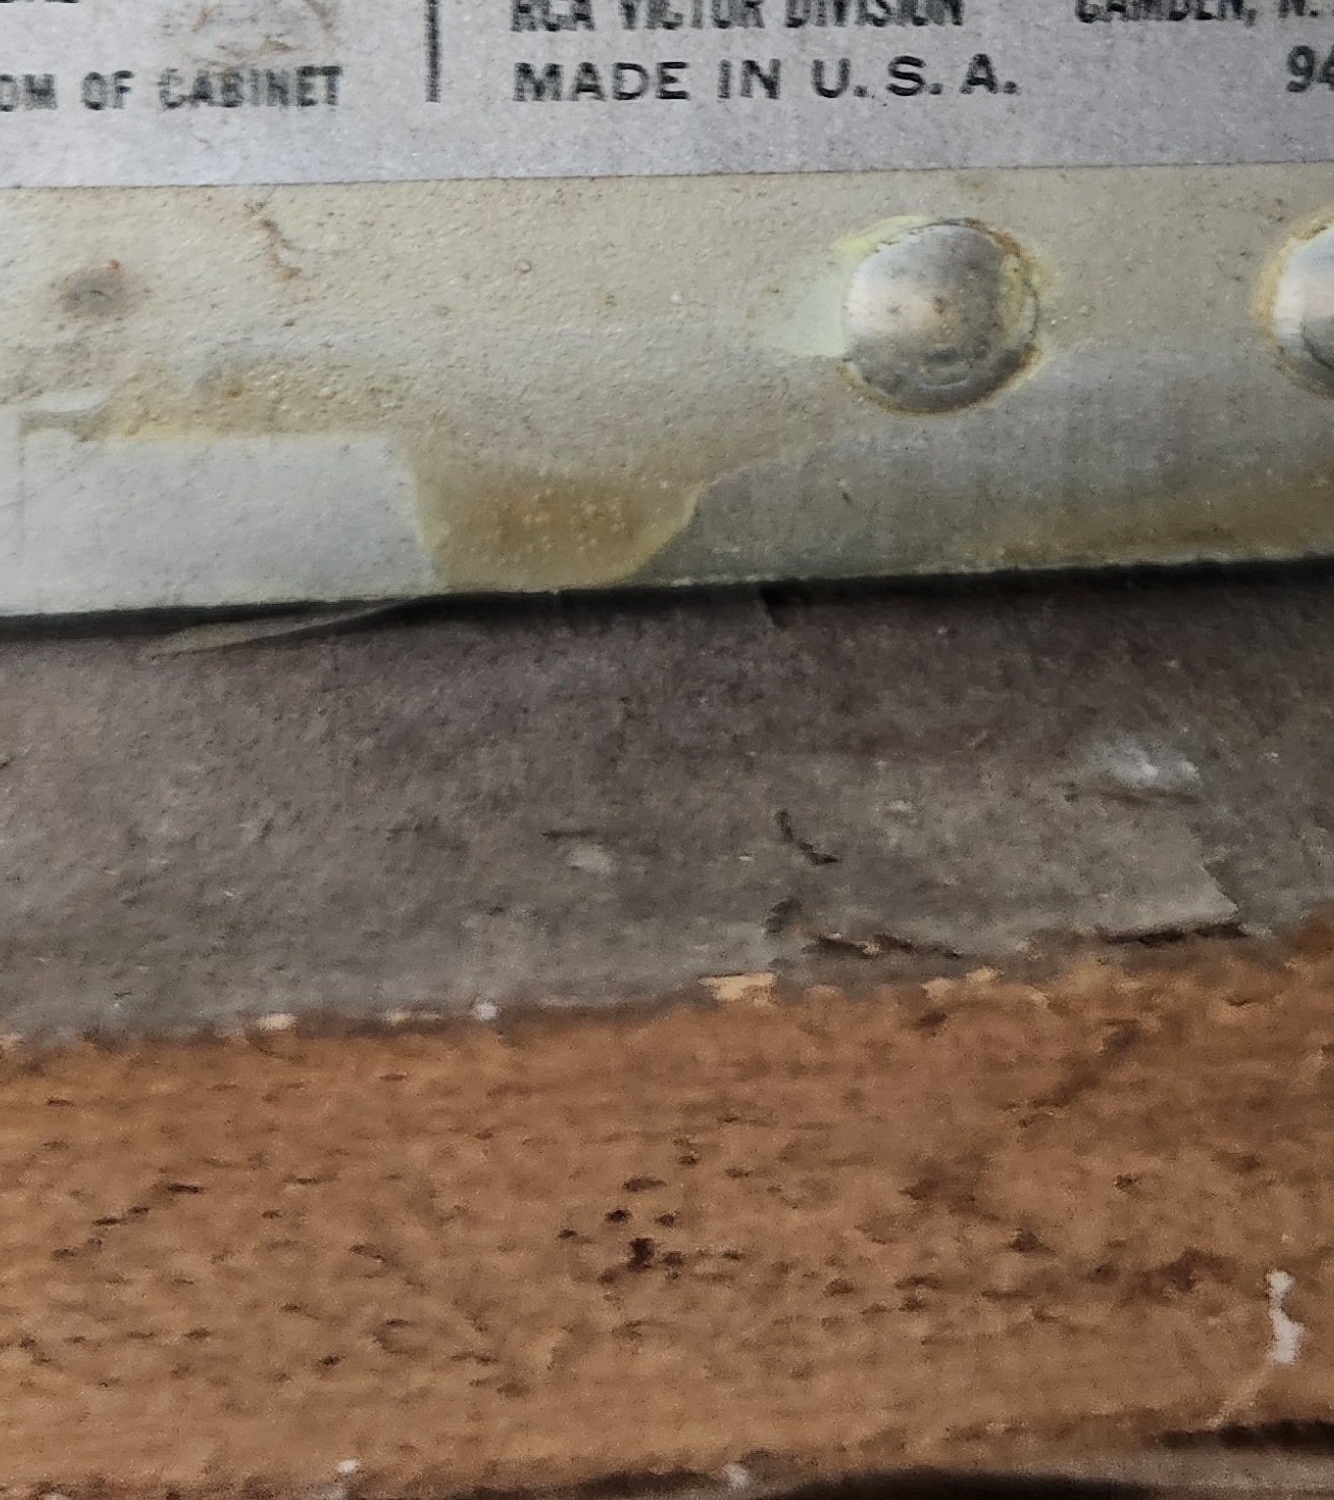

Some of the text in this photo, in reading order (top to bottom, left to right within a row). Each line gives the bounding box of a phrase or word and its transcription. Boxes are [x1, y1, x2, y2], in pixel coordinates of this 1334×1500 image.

[80, 69, 135, 111] OF
[158, 64, 344, 109] CABINET
[512, 60, 690, 102] MADE
[717, 57, 782, 100] IN
